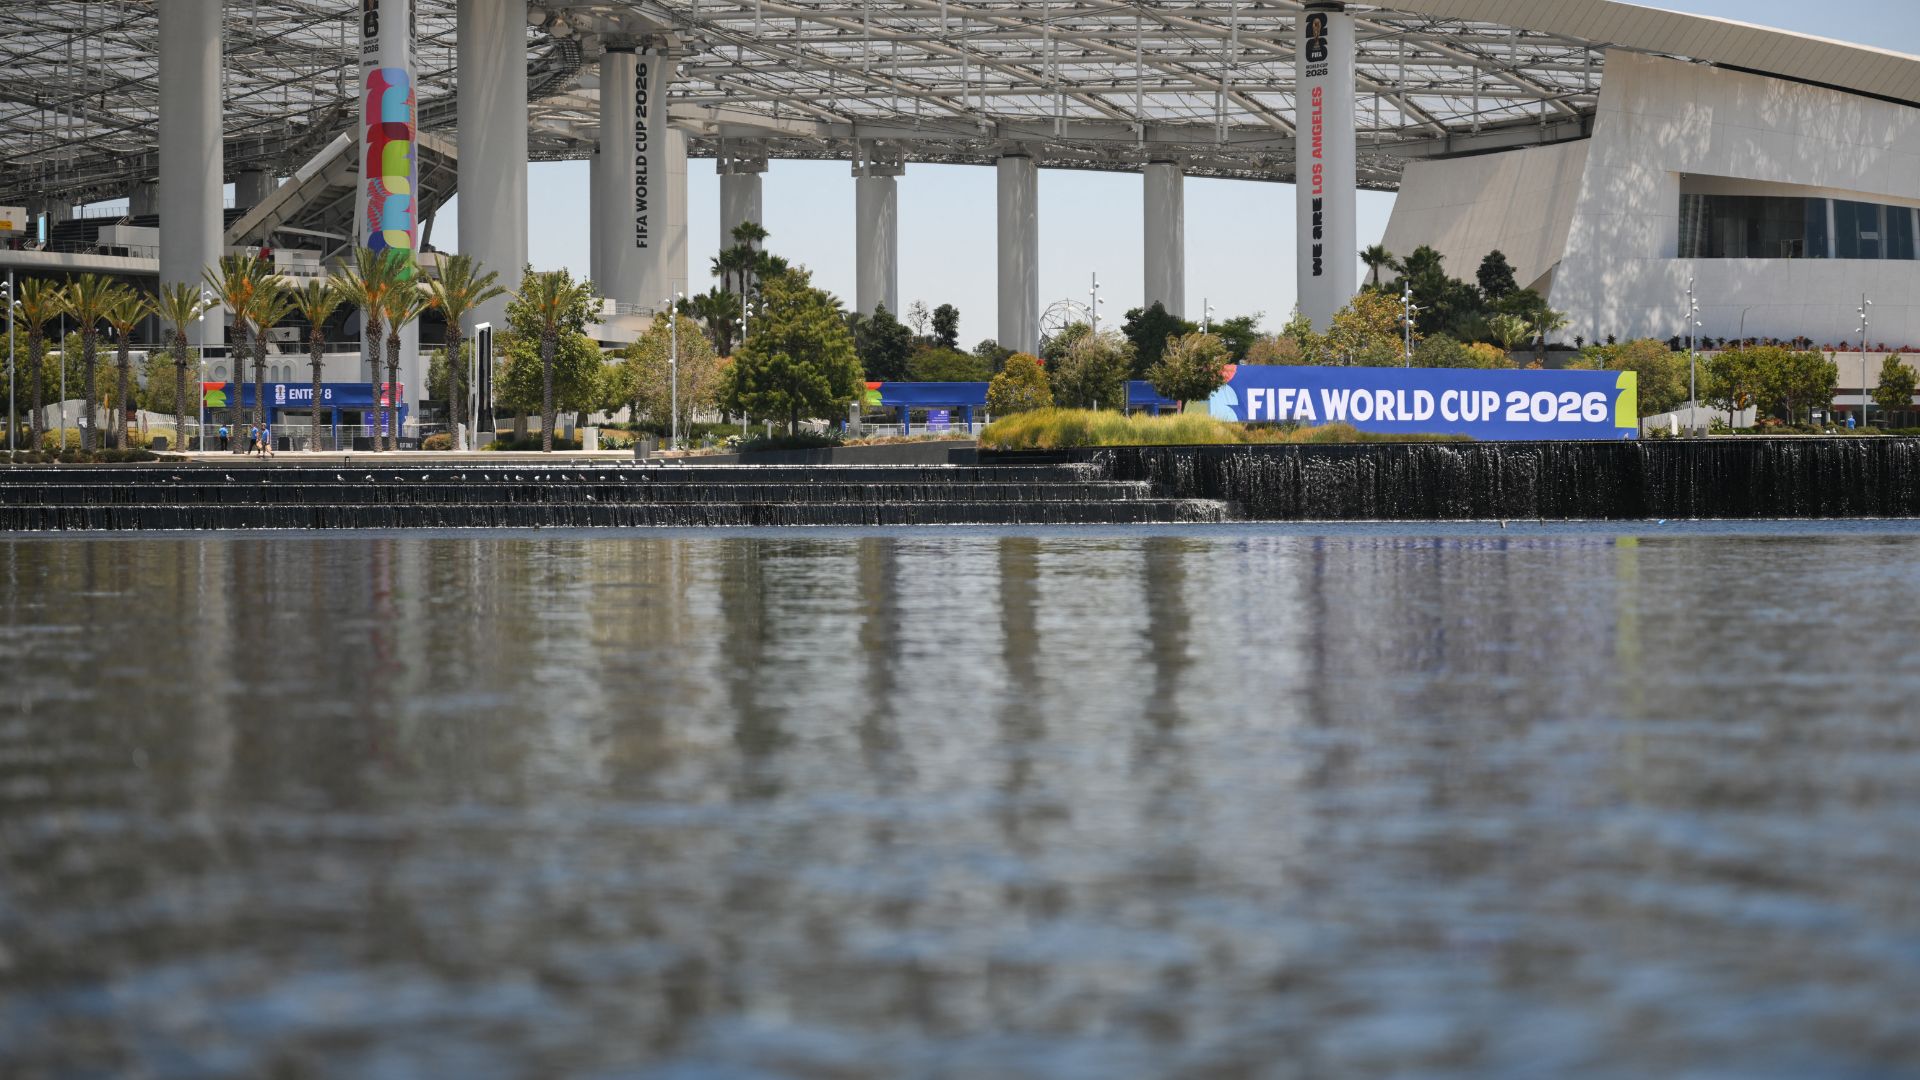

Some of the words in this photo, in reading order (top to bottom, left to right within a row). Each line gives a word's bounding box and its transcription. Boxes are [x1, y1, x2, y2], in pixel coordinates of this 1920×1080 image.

[1305, 68, 1328, 77] 2026
[636, 63, 647, 118] 2026
[636, 121, 647, 153] CUP
[1312, 86, 1323, 159] ANGELES
[636, 156, 647, 214] WORLD
[1312, 163, 1323, 195] LOS
[636, 215, 647, 248] FIFA
[1312, 243, 1323, 277] WE
[324, 388, 332, 399] 8
[1246, 388, 1318, 421] FIFA
[1320, 388, 1436, 422] WORLD
[1439, 389, 1502, 422] CUP
[1505, 390, 1609, 423] 2026
